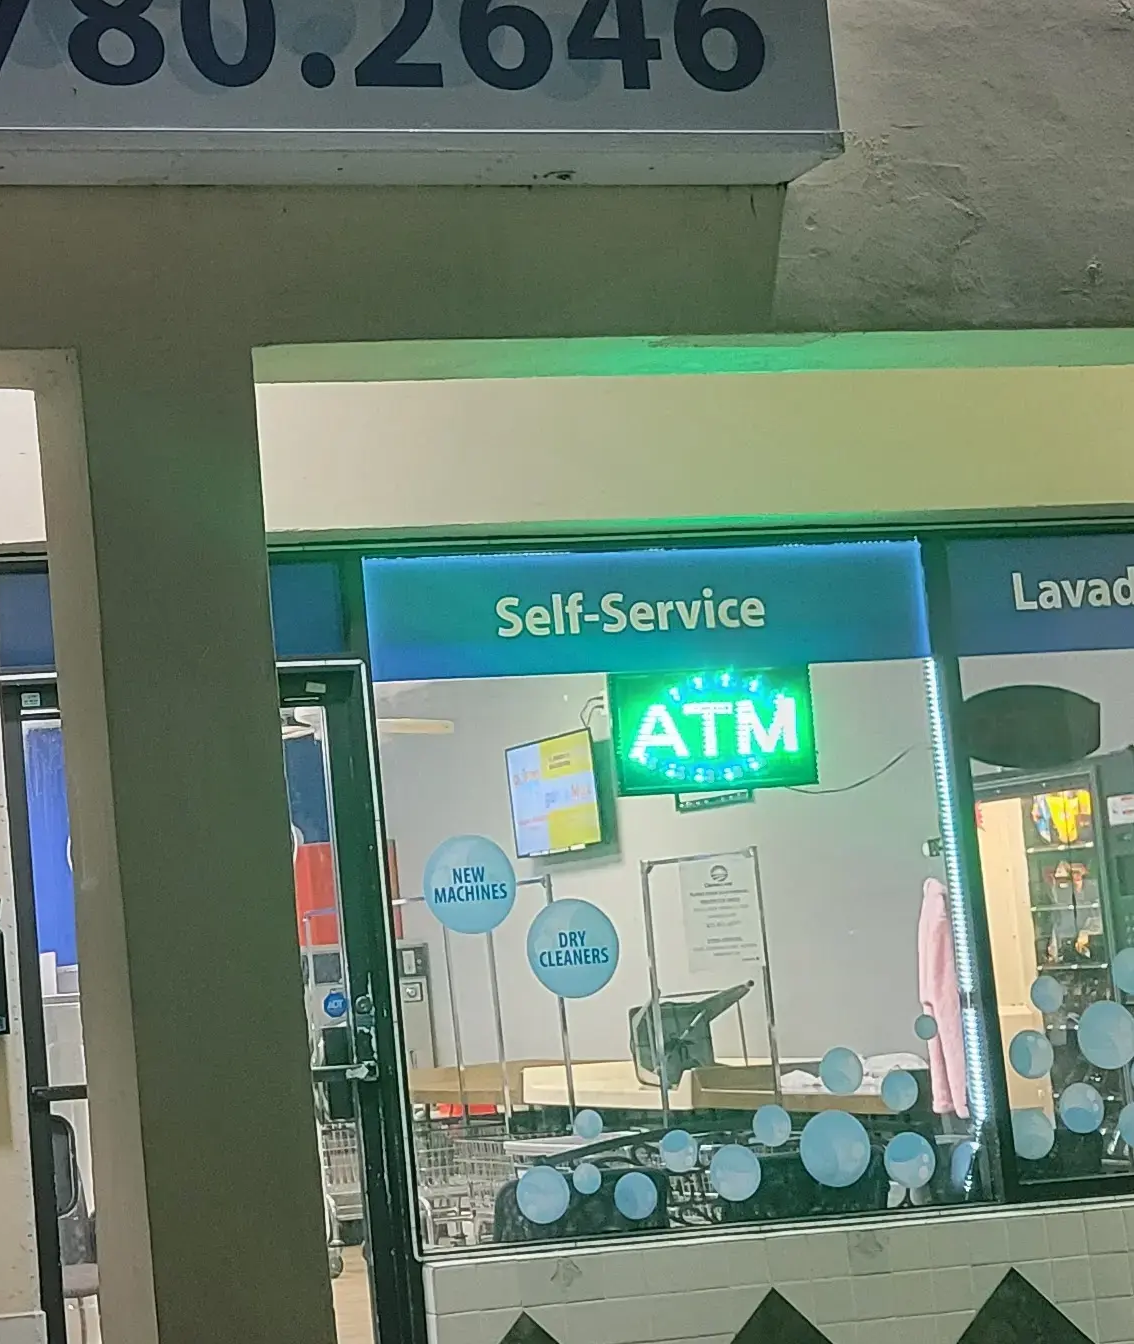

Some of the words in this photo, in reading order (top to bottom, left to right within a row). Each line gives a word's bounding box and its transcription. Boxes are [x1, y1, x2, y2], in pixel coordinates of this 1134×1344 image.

[495, 587, 766, 638] Self-Service
[628, 693, 800, 764] ATM
[452, 866, 485, 884] NEW
[434, 883, 508, 904] MACHINES
[558, 930, 586, 948] DRY
[539, 947, 609, 968] CLEANERS
